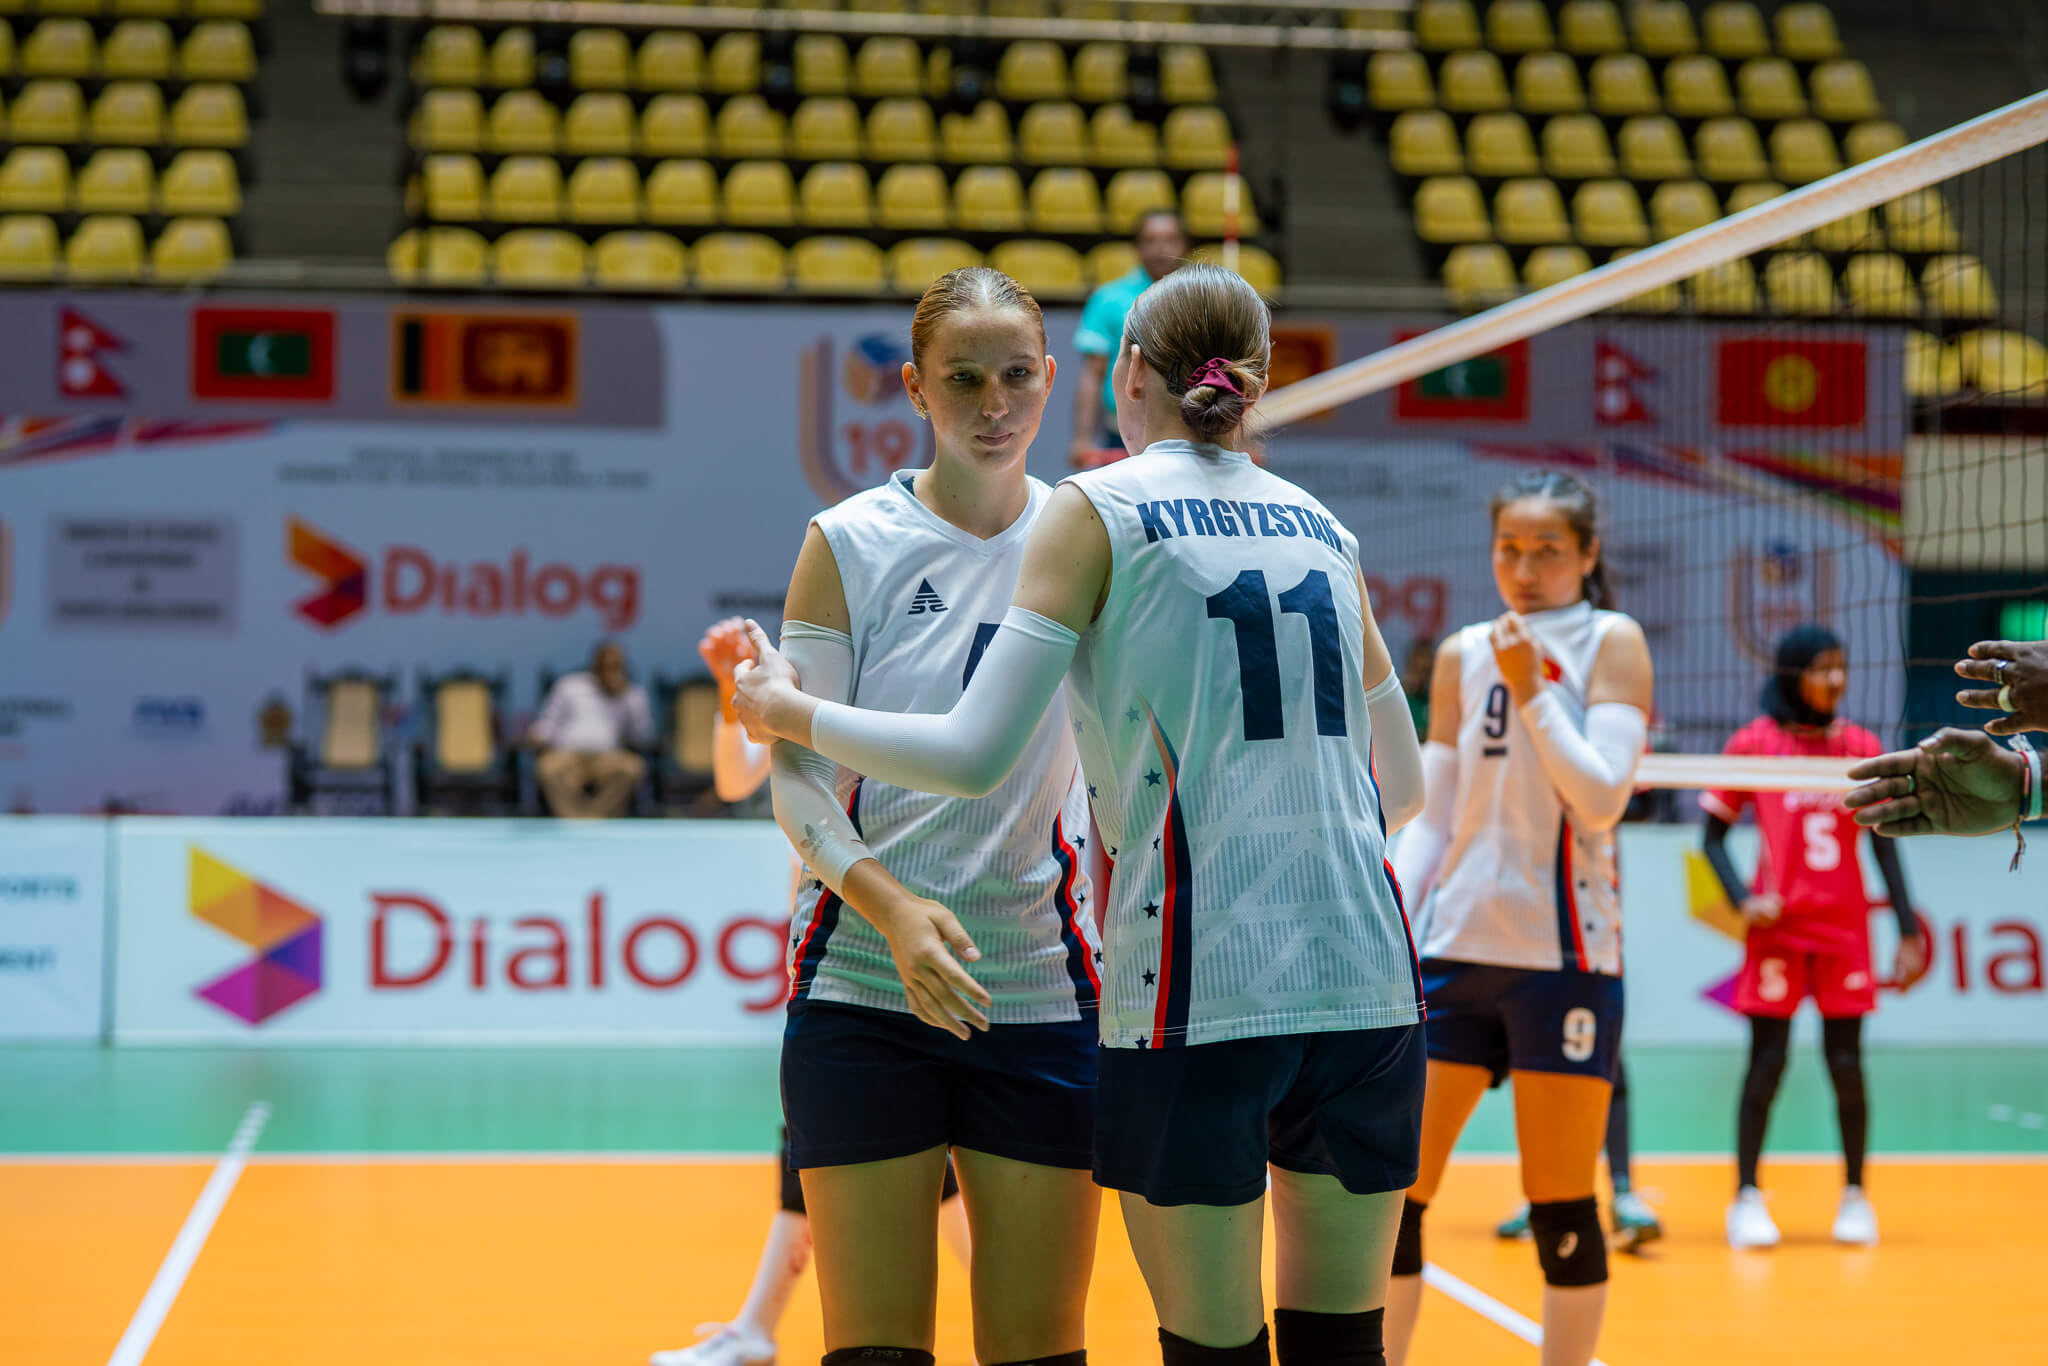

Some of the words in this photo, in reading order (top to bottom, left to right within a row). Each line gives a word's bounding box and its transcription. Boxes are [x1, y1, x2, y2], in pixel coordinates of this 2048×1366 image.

[1136, 499, 1342, 553] KYRGYZSTAN
[382, 546, 640, 632] Dialog
[1206, 568, 1348, 741] 11
[1484, 684, 1509, 739] 9
[1803, 812, 1841, 870] 5
[368, 892, 786, 1014] Dialog
[1562, 1008, 1597, 1062] 9
